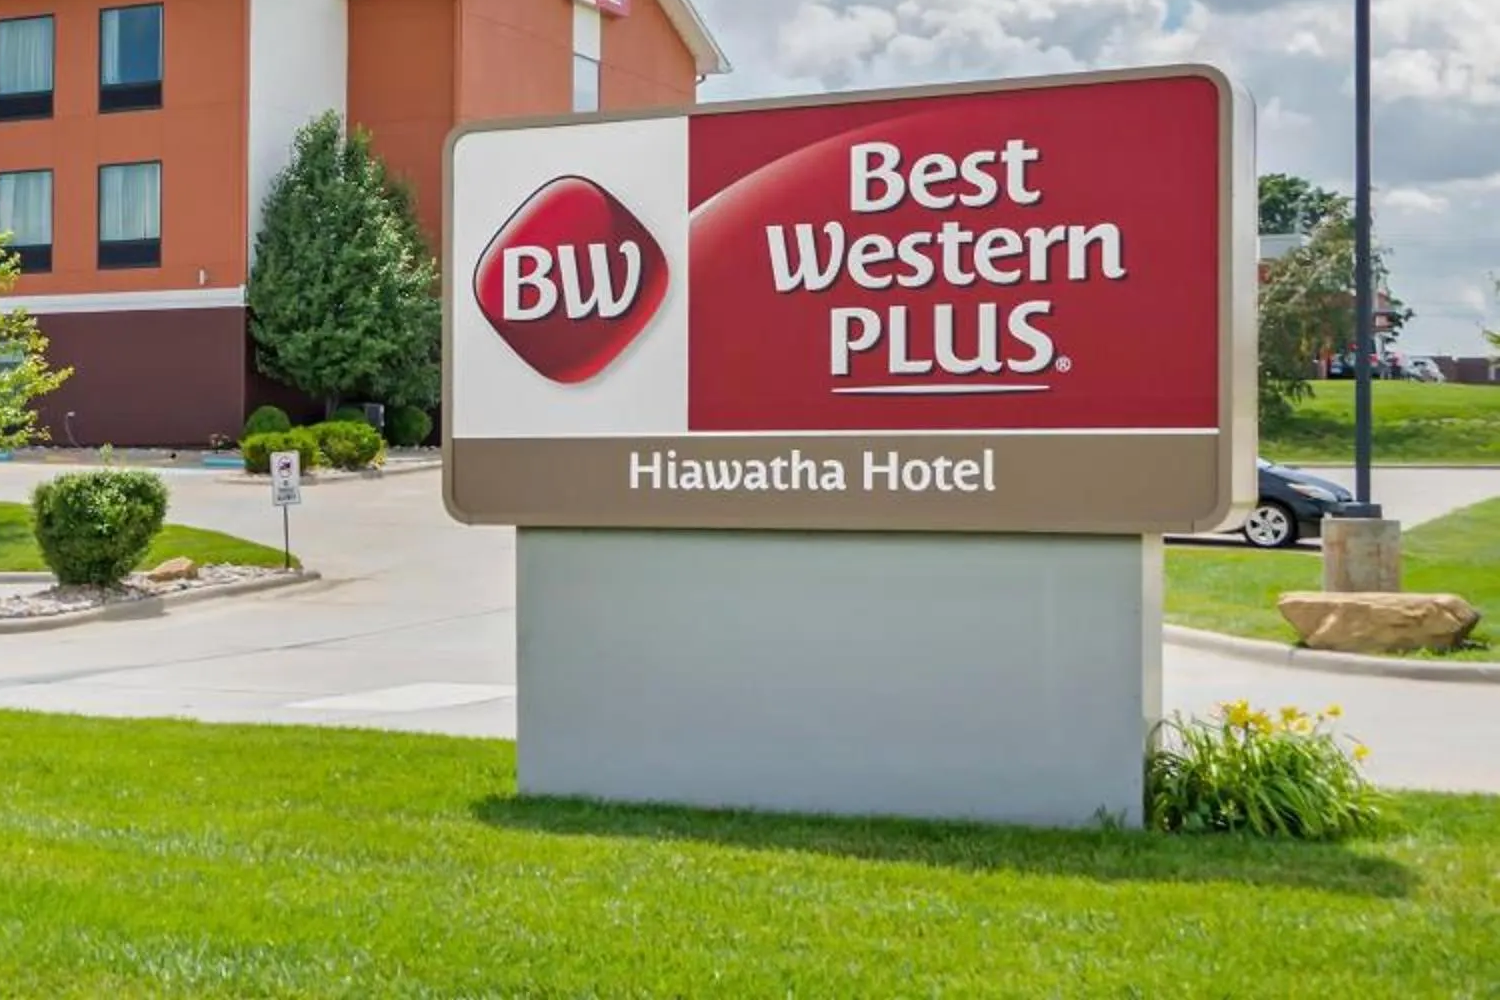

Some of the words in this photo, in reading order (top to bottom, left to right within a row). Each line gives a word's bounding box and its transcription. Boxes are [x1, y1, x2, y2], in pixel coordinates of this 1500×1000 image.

[850, 140, 1041, 212] Best
[502, 241, 642, 321] BW
[766, 221, 1126, 292] Western
[629, 449, 848, 491] Hiawatha
[862, 449, 996, 492] Hotel
